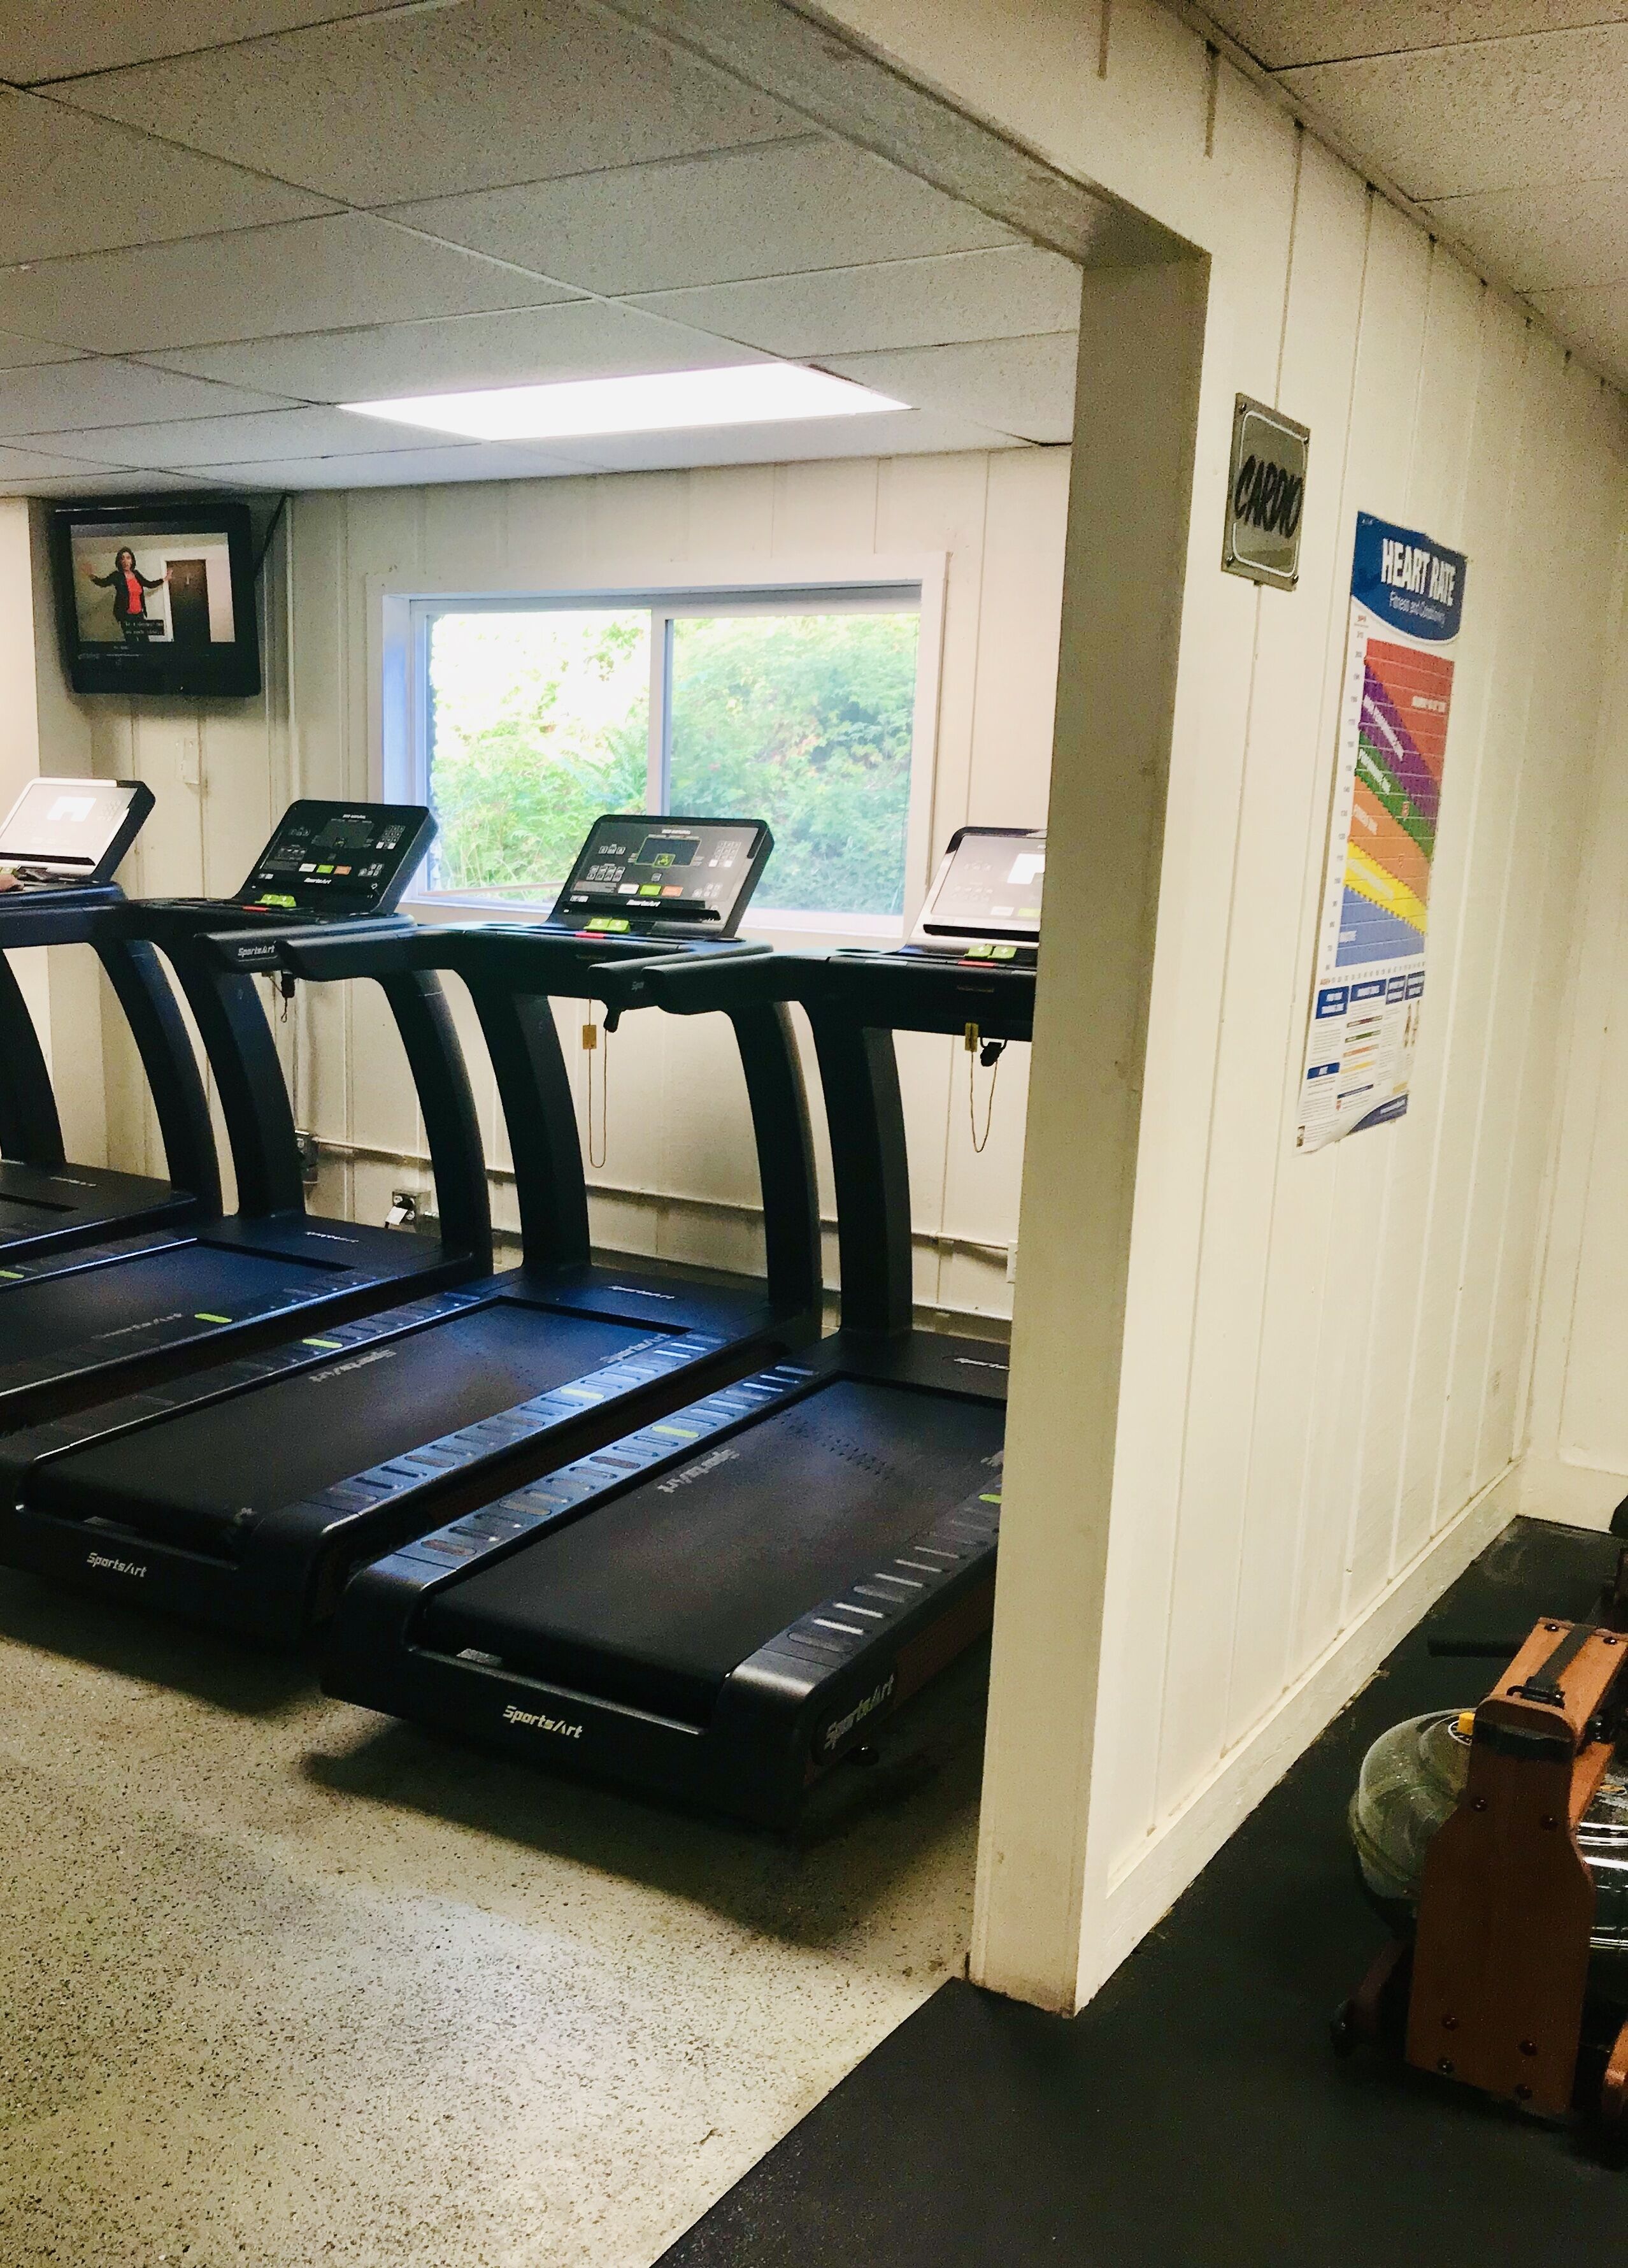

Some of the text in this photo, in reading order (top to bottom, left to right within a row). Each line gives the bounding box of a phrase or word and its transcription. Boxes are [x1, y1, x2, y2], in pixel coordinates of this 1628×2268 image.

[1234, 454, 1303, 539] CARDIO
[1381, 538, 1456, 606] HEART RATE
[238, 945, 275, 958] SportsArt
[87, 1552, 147, 1578] SportsArt
[502, 1705, 583, 1739] SportsArt
